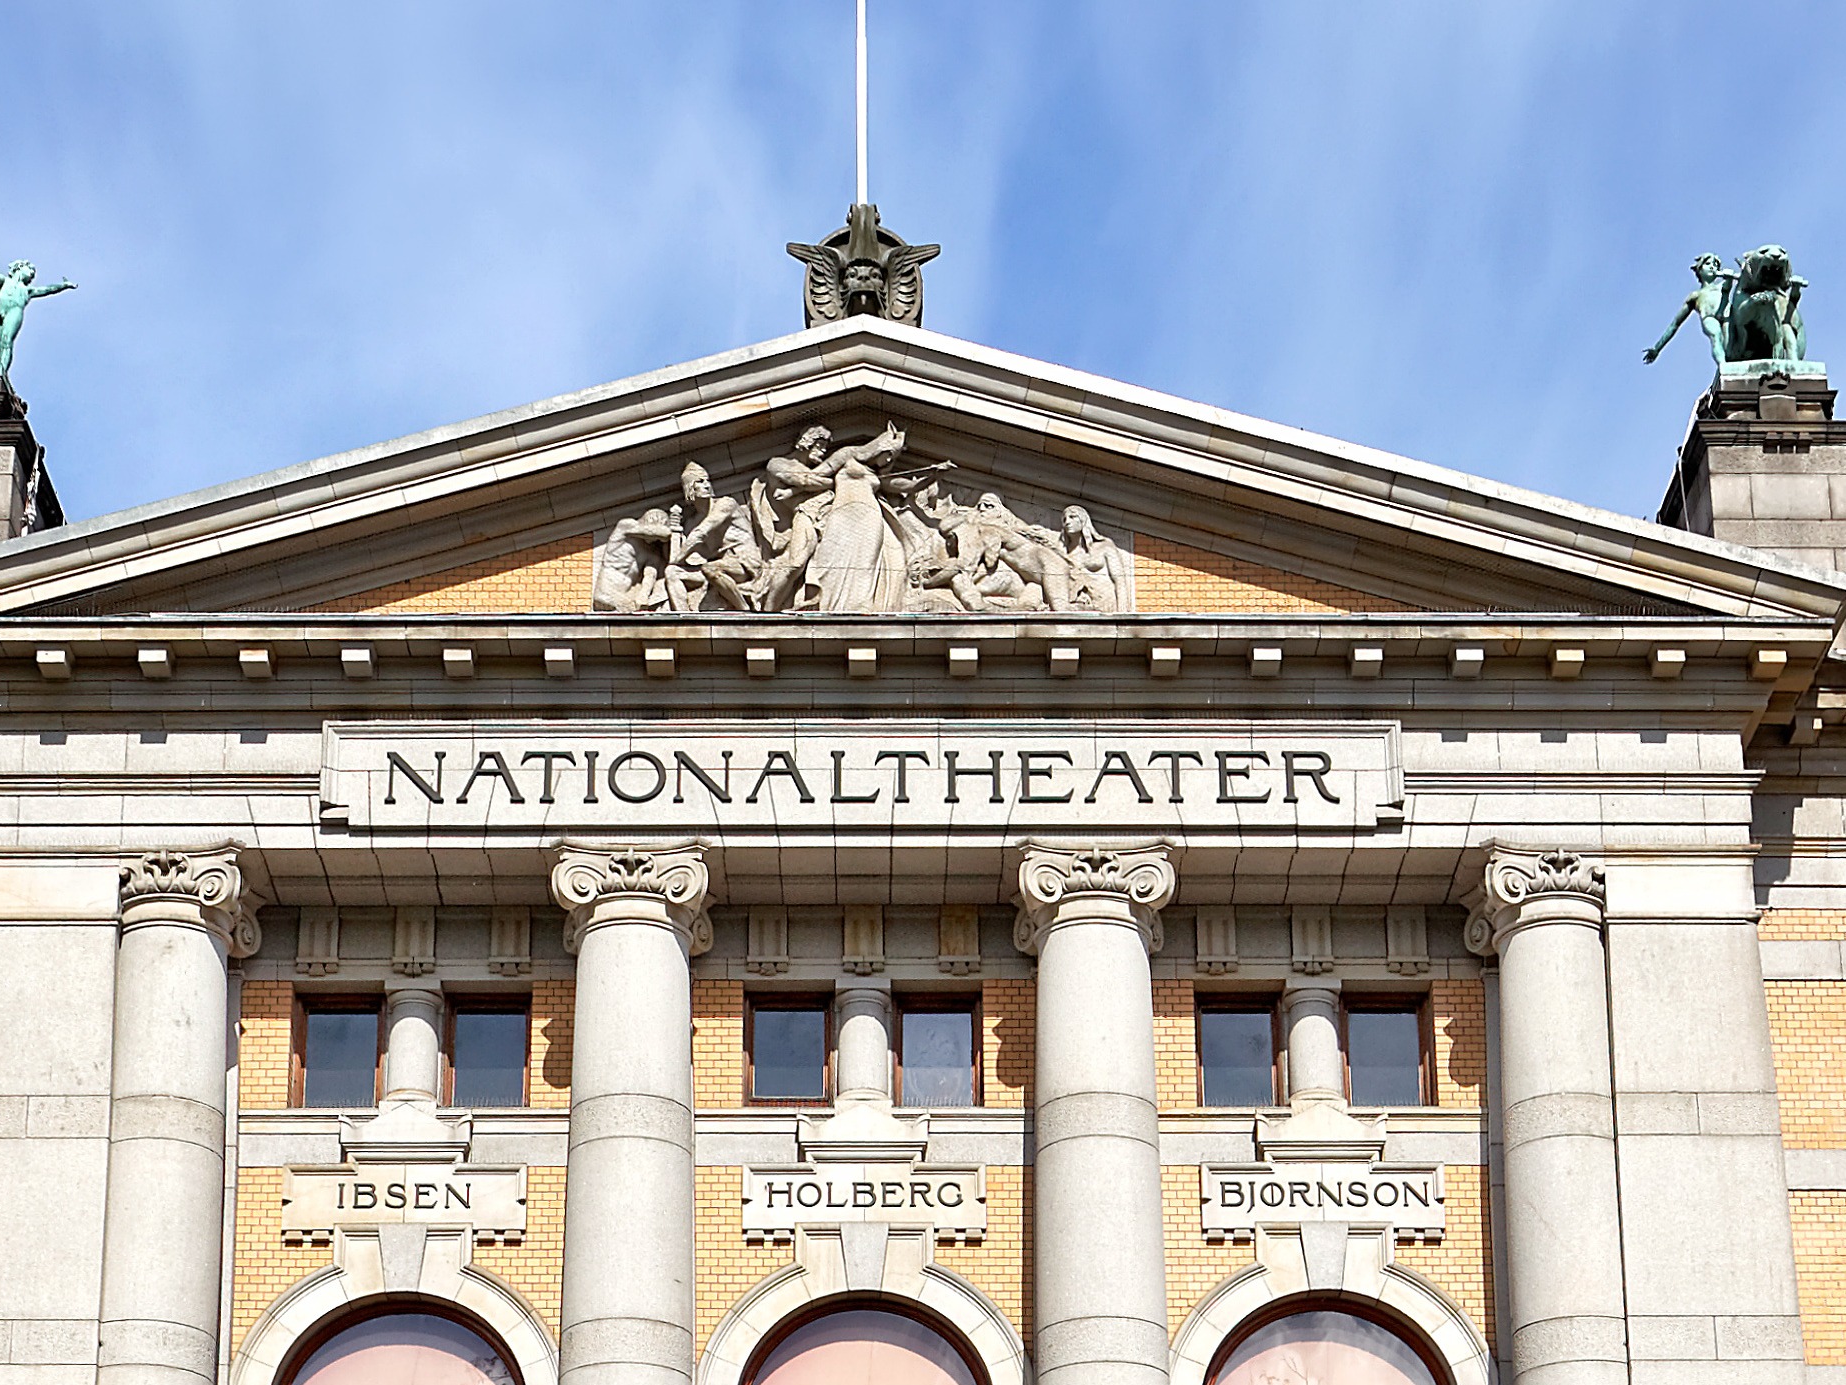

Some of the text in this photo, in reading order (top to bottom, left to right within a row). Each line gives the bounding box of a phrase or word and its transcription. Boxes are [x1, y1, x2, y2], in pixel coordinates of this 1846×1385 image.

[384, 749, 1340, 804] NATIONALTHEATER
[336, 1182, 472, 1210] IBSEN
[766, 1181, 964, 1208] HOLBERG
[1219, 1181, 1430, 1213] BJØRNSON
